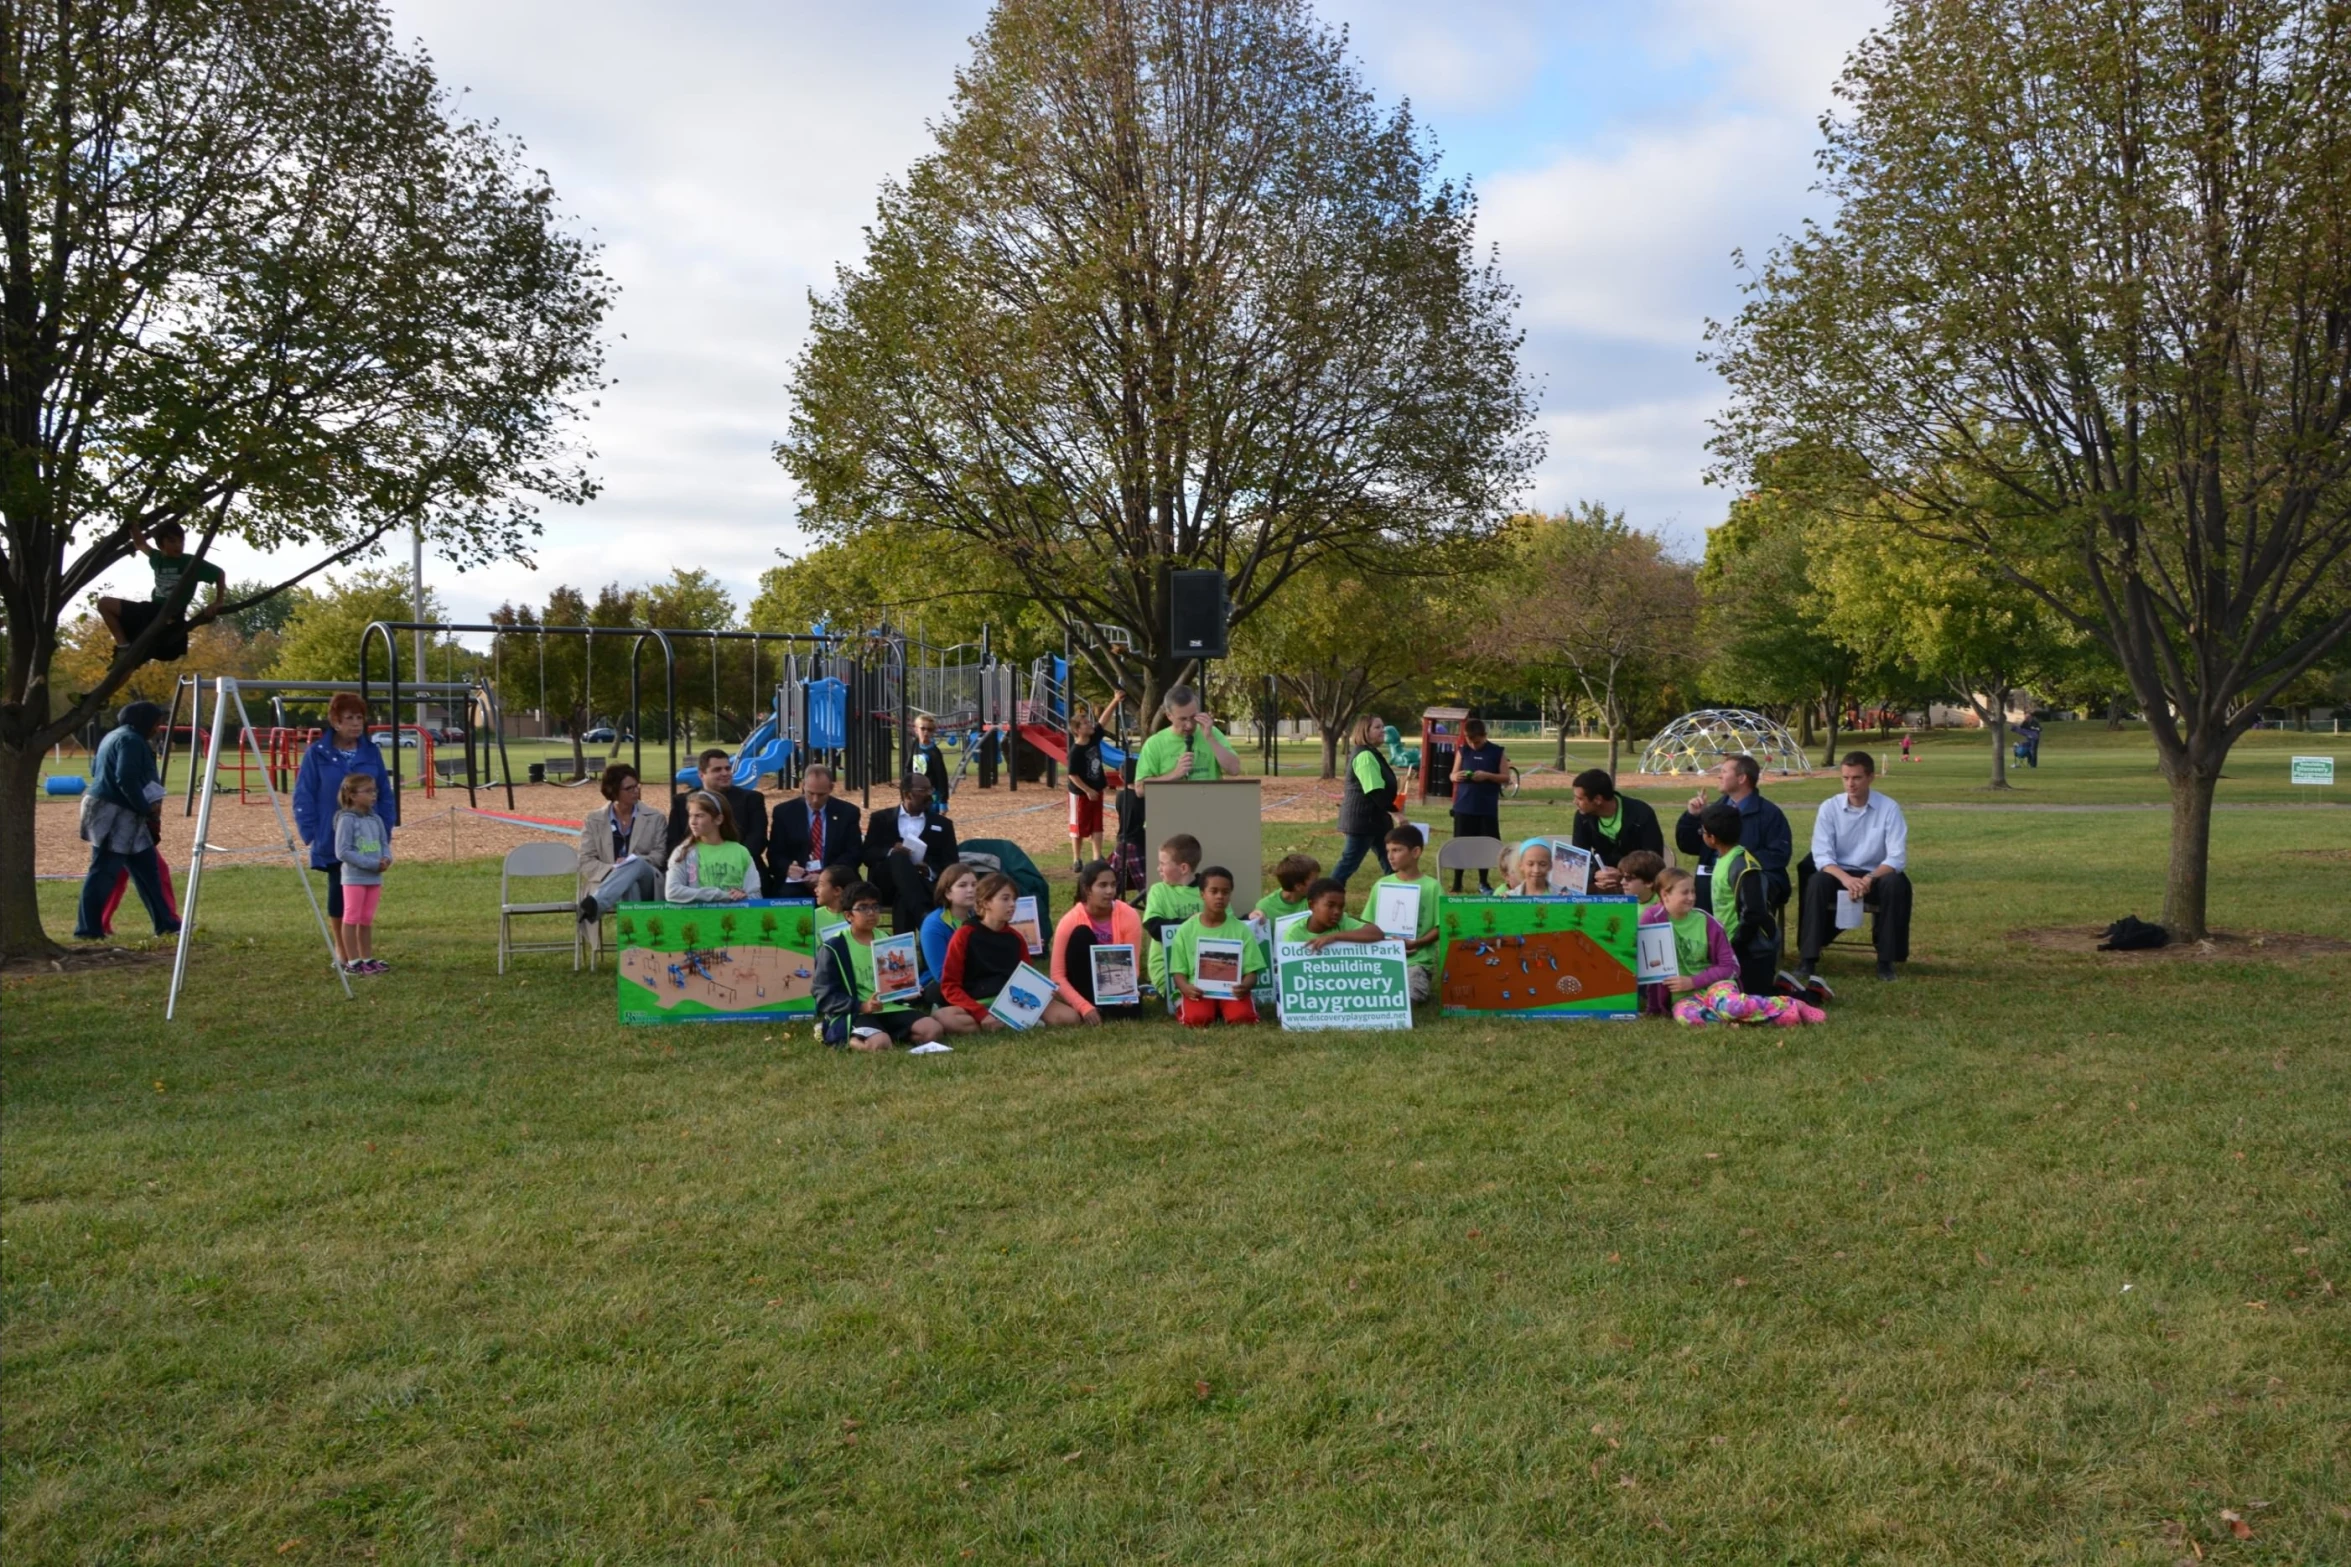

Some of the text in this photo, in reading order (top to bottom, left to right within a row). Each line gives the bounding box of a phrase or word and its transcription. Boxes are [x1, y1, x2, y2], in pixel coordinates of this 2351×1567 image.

[634, 903, 663, 911] Discovery
[664, 902, 698, 910] Playground
[1502, 897, 1532, 905] Discovery
[1533, 896, 1568, 904] Playground
[1571, 896, 1592, 904] Option
[1602, 896, 1628, 904] Starlight
[1371, 943, 1401, 956] Park
[1302, 960, 1382, 974] Rebuilding
[1293, 975, 1393, 993] Discovery
[1285, 990, 1405, 1013] Playground
[1286, 1012, 1407, 1022] www.discoveryplayground.net
